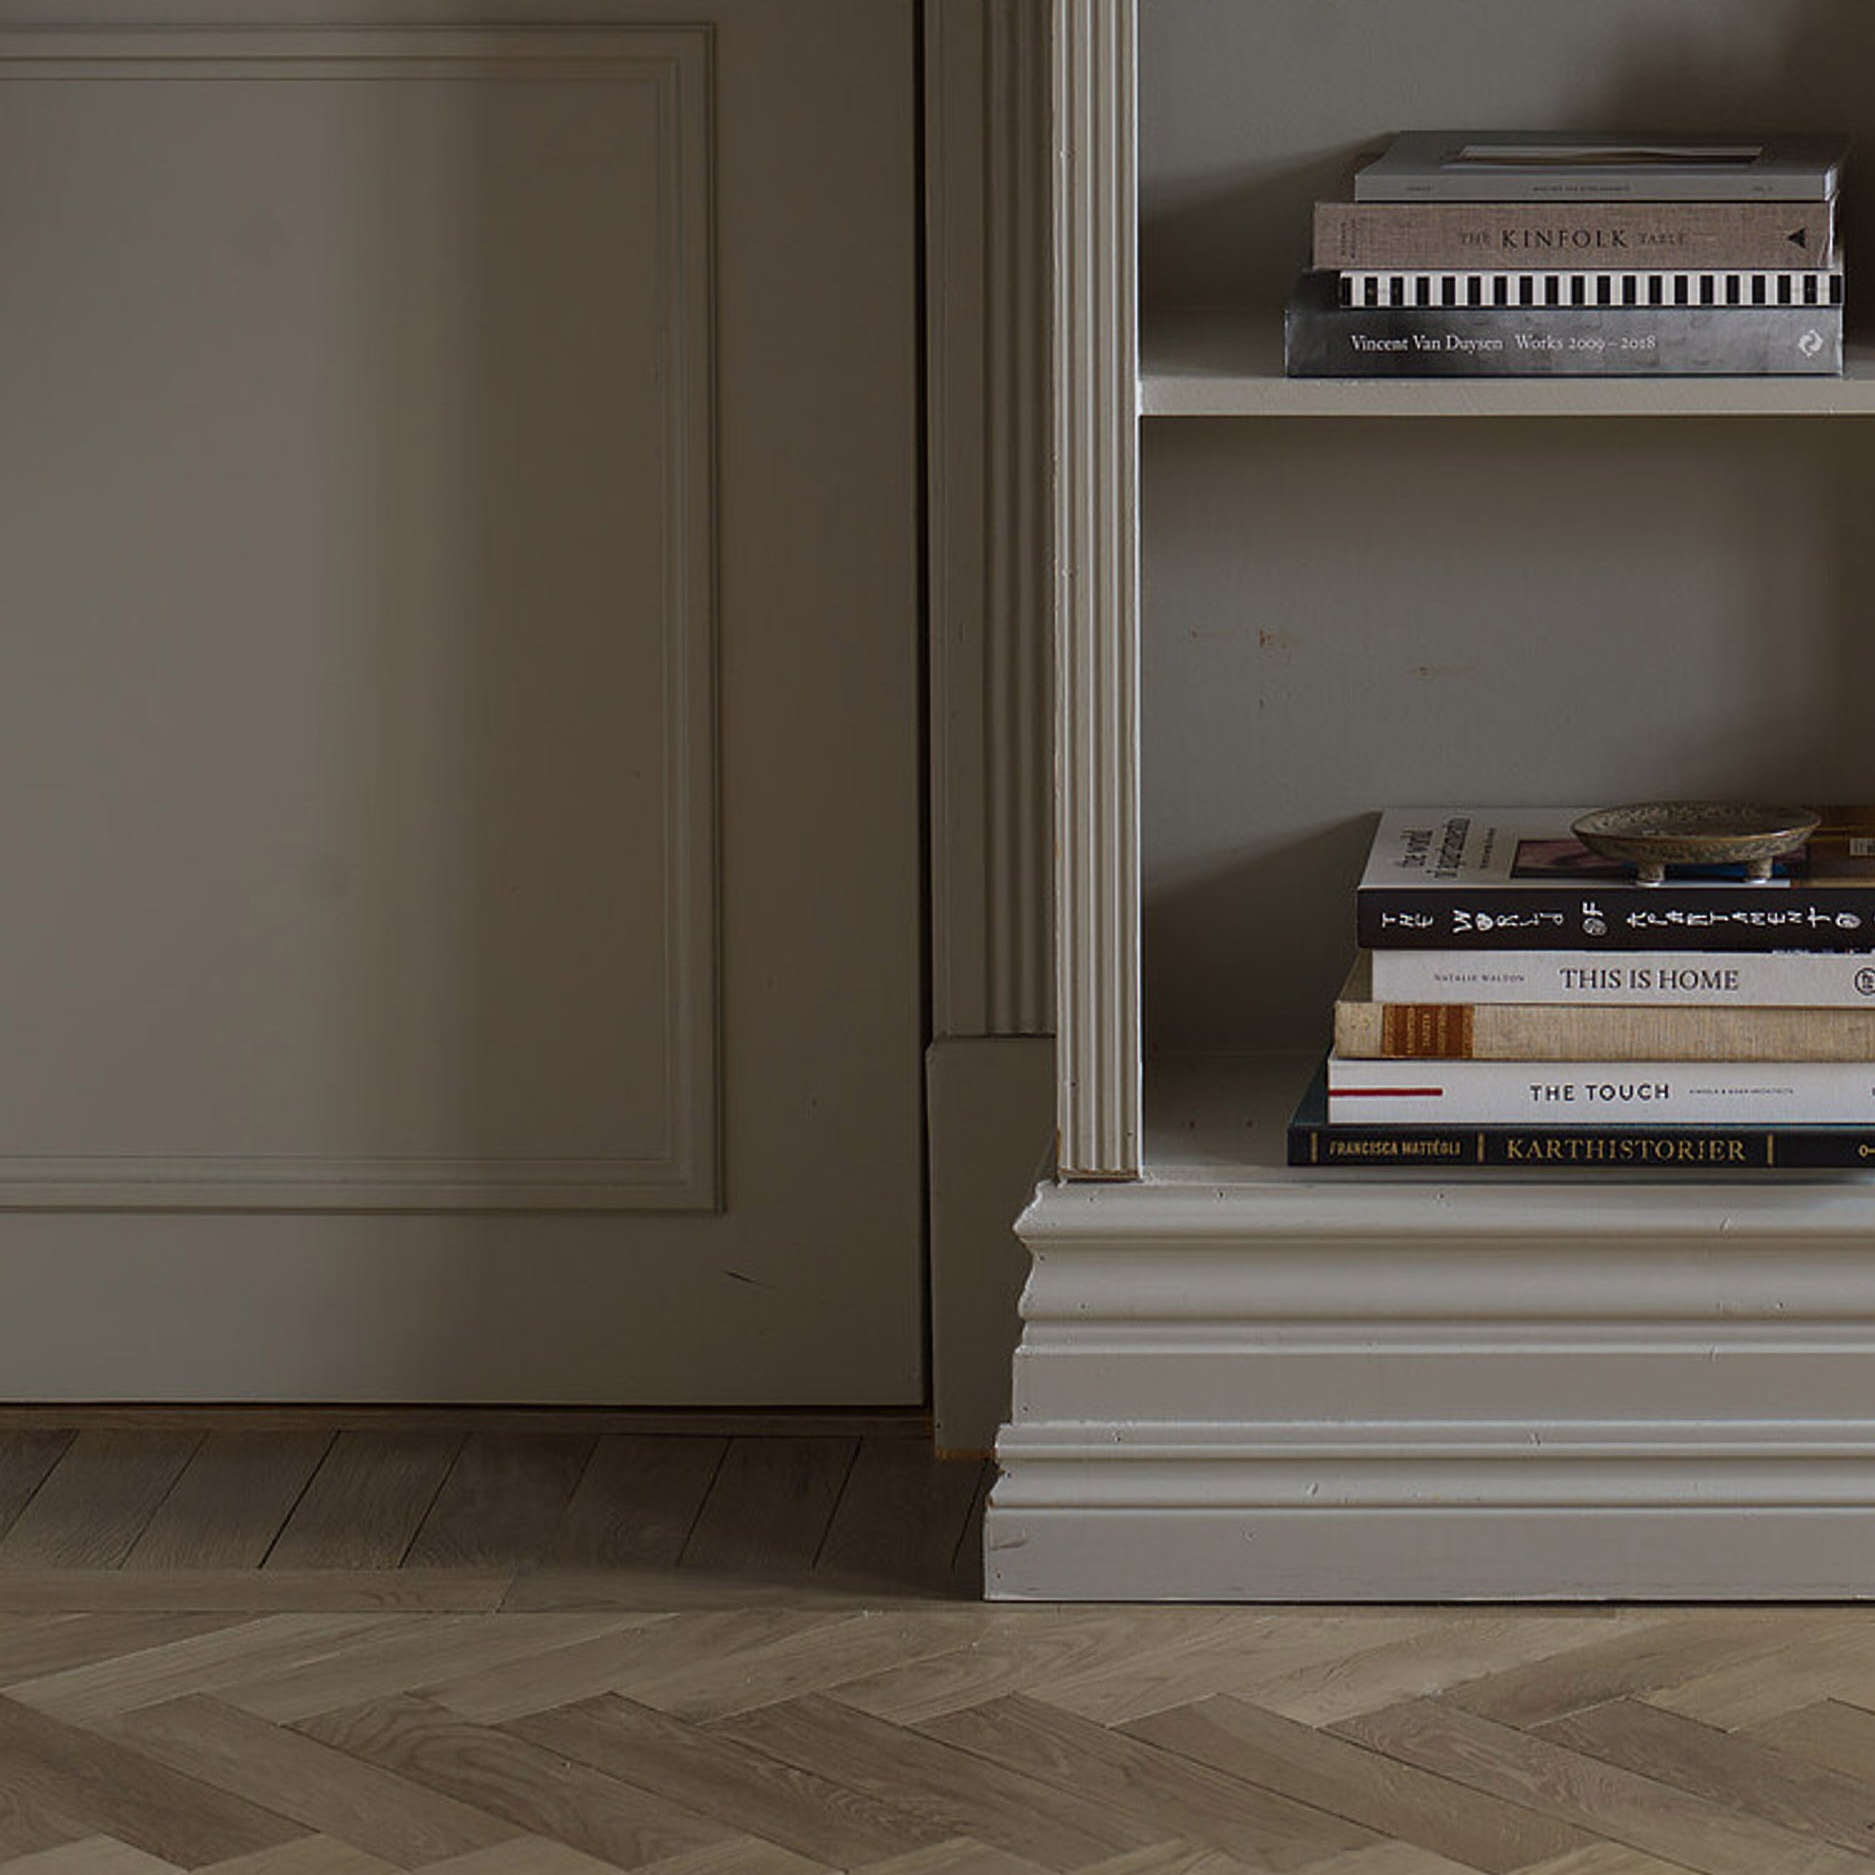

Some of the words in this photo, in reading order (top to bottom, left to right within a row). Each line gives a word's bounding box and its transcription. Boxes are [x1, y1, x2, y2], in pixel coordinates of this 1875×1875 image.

[1460, 232, 1490, 246] THE
[1502, 229, 1629, 249] KINFOLK
[1639, 232, 1686, 246] TABLE
[1350, 334, 1409, 352] Vincent
[1412, 335, 1441, 351] Van
[1445, 335, 1504, 355] Duysen
[1514, 334, 1564, 351] Works
[1382, 912, 1434, 929] THE
[1452, 909, 1564, 933] WORLD
[1559, 968, 1622, 990] THIS
[1628, 968, 1652, 990] IS
[1658, 968, 1740, 991] HOME
[1529, 1083, 1576, 1102] THE
[1584, 1083, 1670, 1102] TOUCH
[1329, 1140, 1399, 1156] FRANCISCA
[1506, 1138, 1747, 1162] KARTHISTORIER
